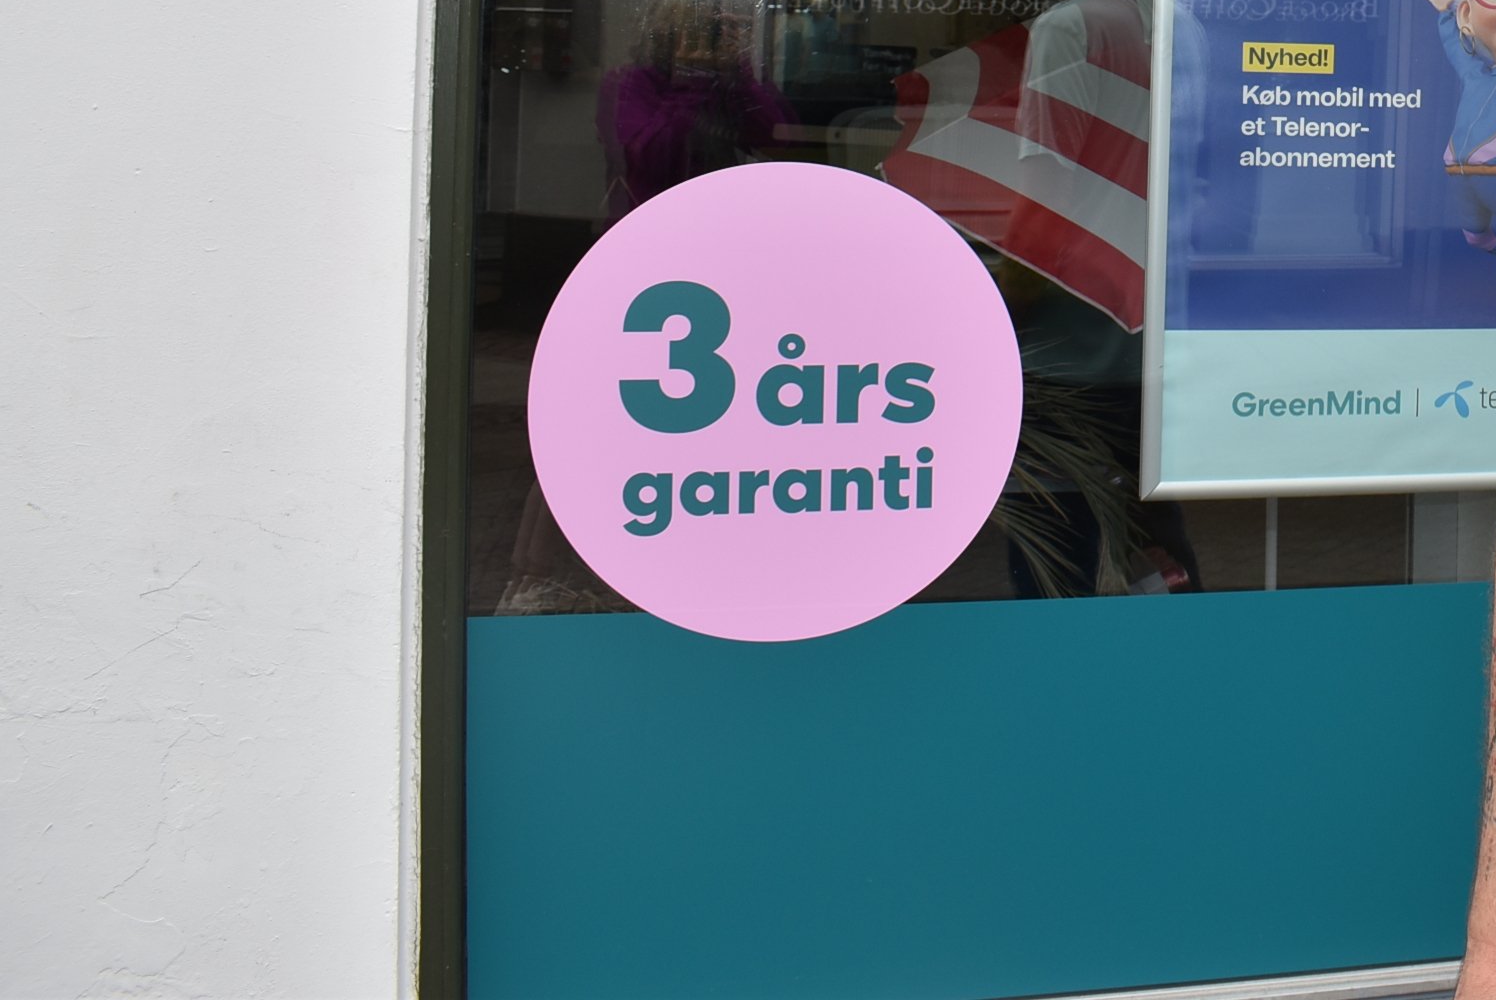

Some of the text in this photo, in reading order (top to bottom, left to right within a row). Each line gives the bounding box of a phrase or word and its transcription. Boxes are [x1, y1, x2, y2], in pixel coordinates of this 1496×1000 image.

[1248, 47, 1329, 70] Nyhed!
[1242, 85, 1422, 109] Køb mobil med
[1241, 116, 1370, 138] et Telenor-
[1239, 147, 1396, 169] abonnement
[619, 280, 936, 434] 3 års
[1232, 389, 1401, 417] GreenMind
[621, 446, 935, 537] garanti
